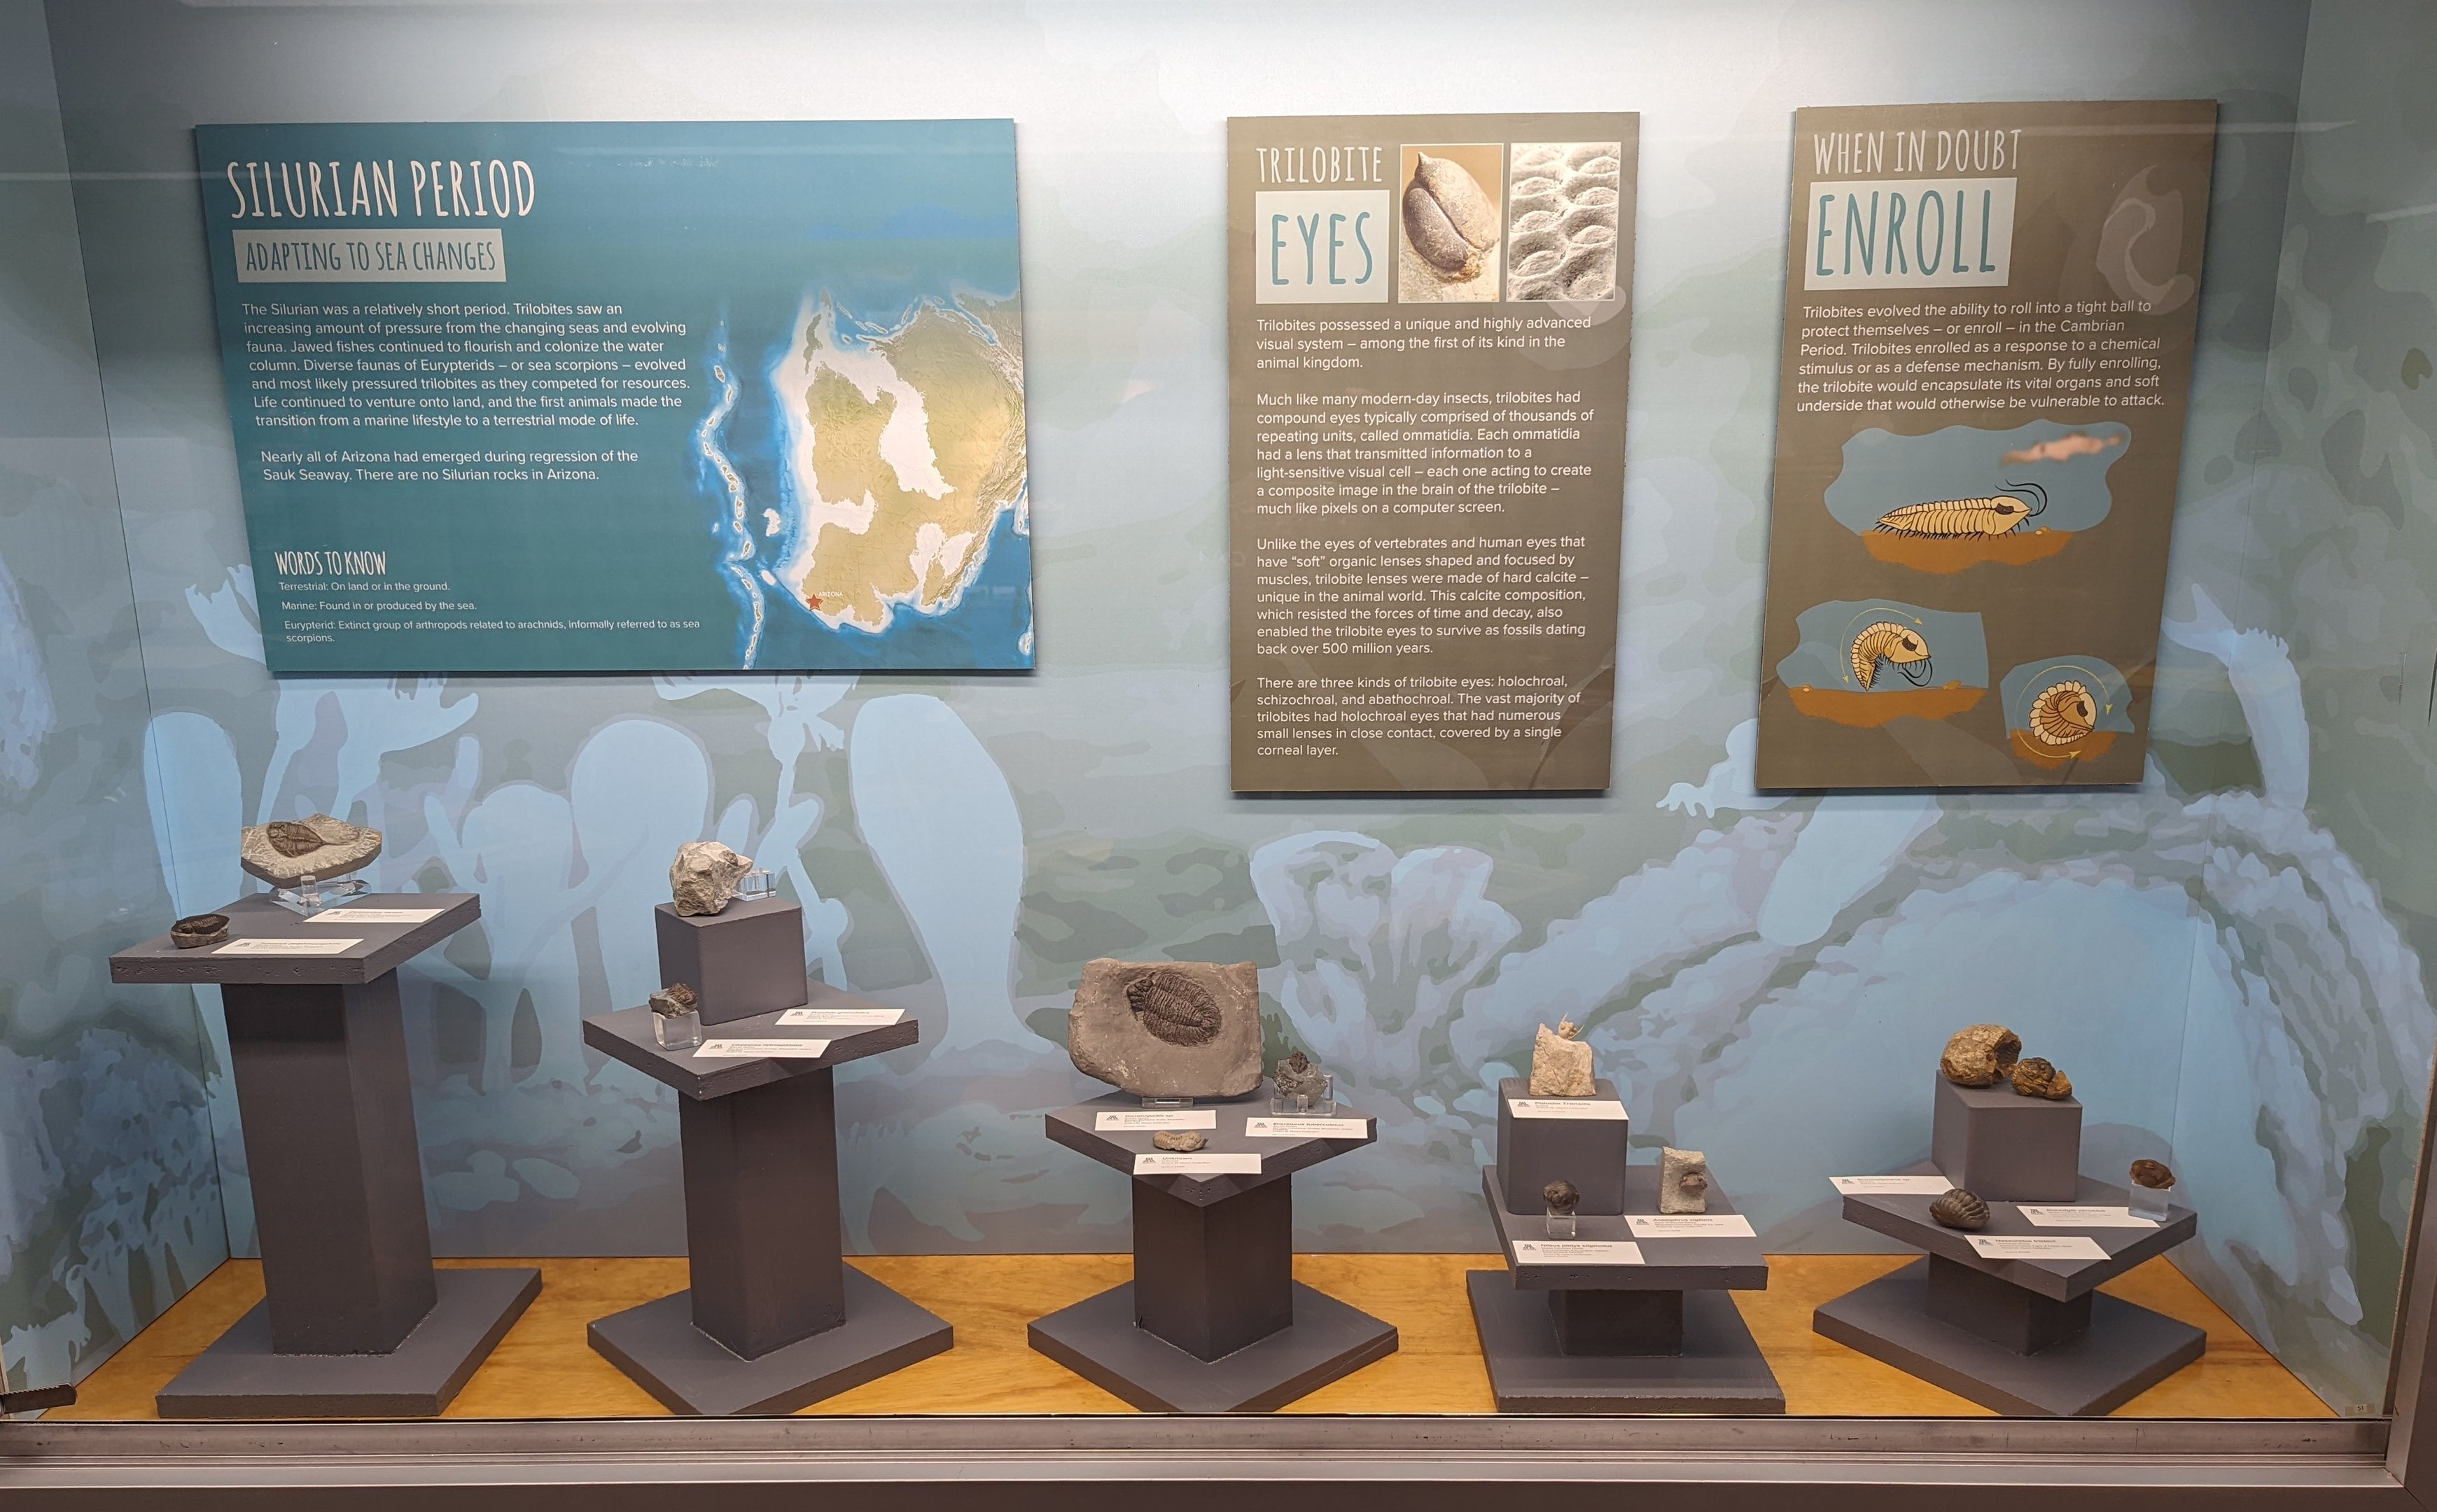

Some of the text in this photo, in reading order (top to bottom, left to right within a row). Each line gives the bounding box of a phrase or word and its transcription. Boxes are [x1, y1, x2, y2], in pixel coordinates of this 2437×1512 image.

[1814, 130, 2021, 174] WHEN IN DOUBT
[1256, 146, 1382, 183] TRILOBITE
[228, 160, 534, 218] SILURIAN PERIOD
[1817, 190, 1995, 276] ENROLL
[246, 242, 495, 271] ADAPTING TO SEA CHANGES
[1272, 212, 1372, 285] EYES
[242, 302, 622, 318] The Silurian was a relatively short period. Trilobites saw an
[1803, 300, 2151, 318] Trilobites evolved the ability to roll into a tight ball to
[244, 321, 686, 337] increasing amount of pressure from the changing seas and evolving
[1256, 316, 1591, 334] Trilobites possessed a unique and highly advanced
[246, 340, 664, 353] fauna. Jawed fishes continued to flourish and colonize the water
[1257, 356, 1363, 371] animal kingdom.
[1257, 391, 1581, 408] Much like many modern-day insects, trilobites had
[1796, 393, 2165, 412] underside that would otherwise be vulnerable to attack.
[1257, 427, 1580, 445] repeating units, called ommatidia. Each ommatidia
[260, 449, 638, 465] Nearly all of Arizona had emerged during regression of the
[263, 468, 599, 483] Sauk Seaway. There are no Silurian rocks in Arizona.
[274, 551, 385, 575] WORDS TO KNOW
[278, 582, 329, 591] Terrestrial:
[330, 582, 346, 591] On
[348, 582, 369, 591] land
[384, 582, 393, 591] in
[394, 582, 411, 591] the
[413, 582, 450, 593] ground.
[281, 601, 316, 610] Marine:
[319, 601, 351, 610] Found
[352, 601, 362, 610] in
[376, 601, 423, 612] produced
[424, 601, 437, 612] by
[438, 601, 455, 610] the
[284, 620, 336, 631] Eurypterid:
[338, 620, 371, 629] Extinct
[372, 622, 401, 631] group
[403, 620, 413, 629] of
[415, 620, 468, 631] arthropods
[470, 620, 503, 629] related
[505, 621, 516, 629] to
[517, 620, 566, 630] arachnids,
[568, 620, 615, 631] informally
[617, 620, 655, 629] referred
[657, 620, 667, 629] to
[286, 635, 335, 644] scorpions.
[1257, 642, 1433, 656] back over 500 million years.
